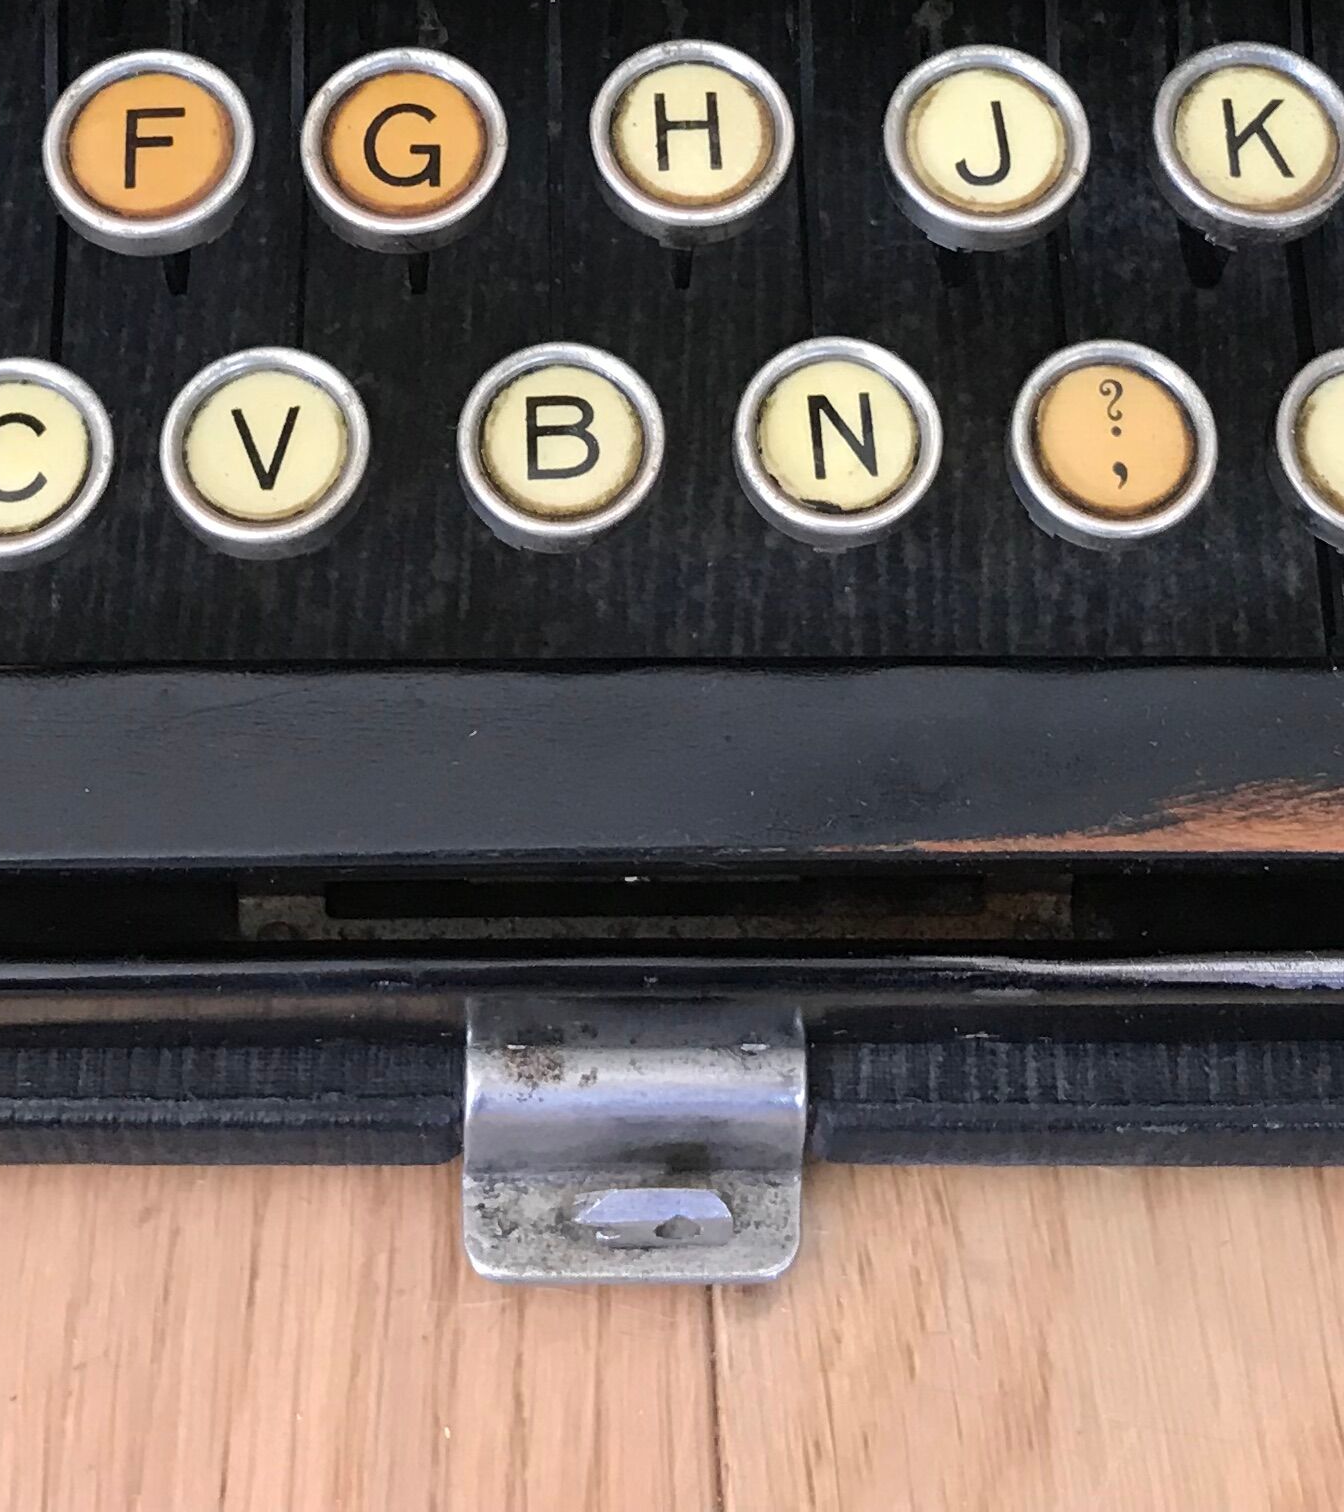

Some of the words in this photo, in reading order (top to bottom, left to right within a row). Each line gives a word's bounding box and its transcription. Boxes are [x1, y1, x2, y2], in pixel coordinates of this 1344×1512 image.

[125, 108, 185, 189] F
[364, 104, 440, 187] G
[655, 92, 722, 171] H
[956, 101, 1010, 186] J
[1223, 99, 1294, 177] K
[231, 406, 300, 490] V
[526, 396, 599, 480] B
[808, 393, 877, 479] N
[1100, 379, 1123, 436] ?
